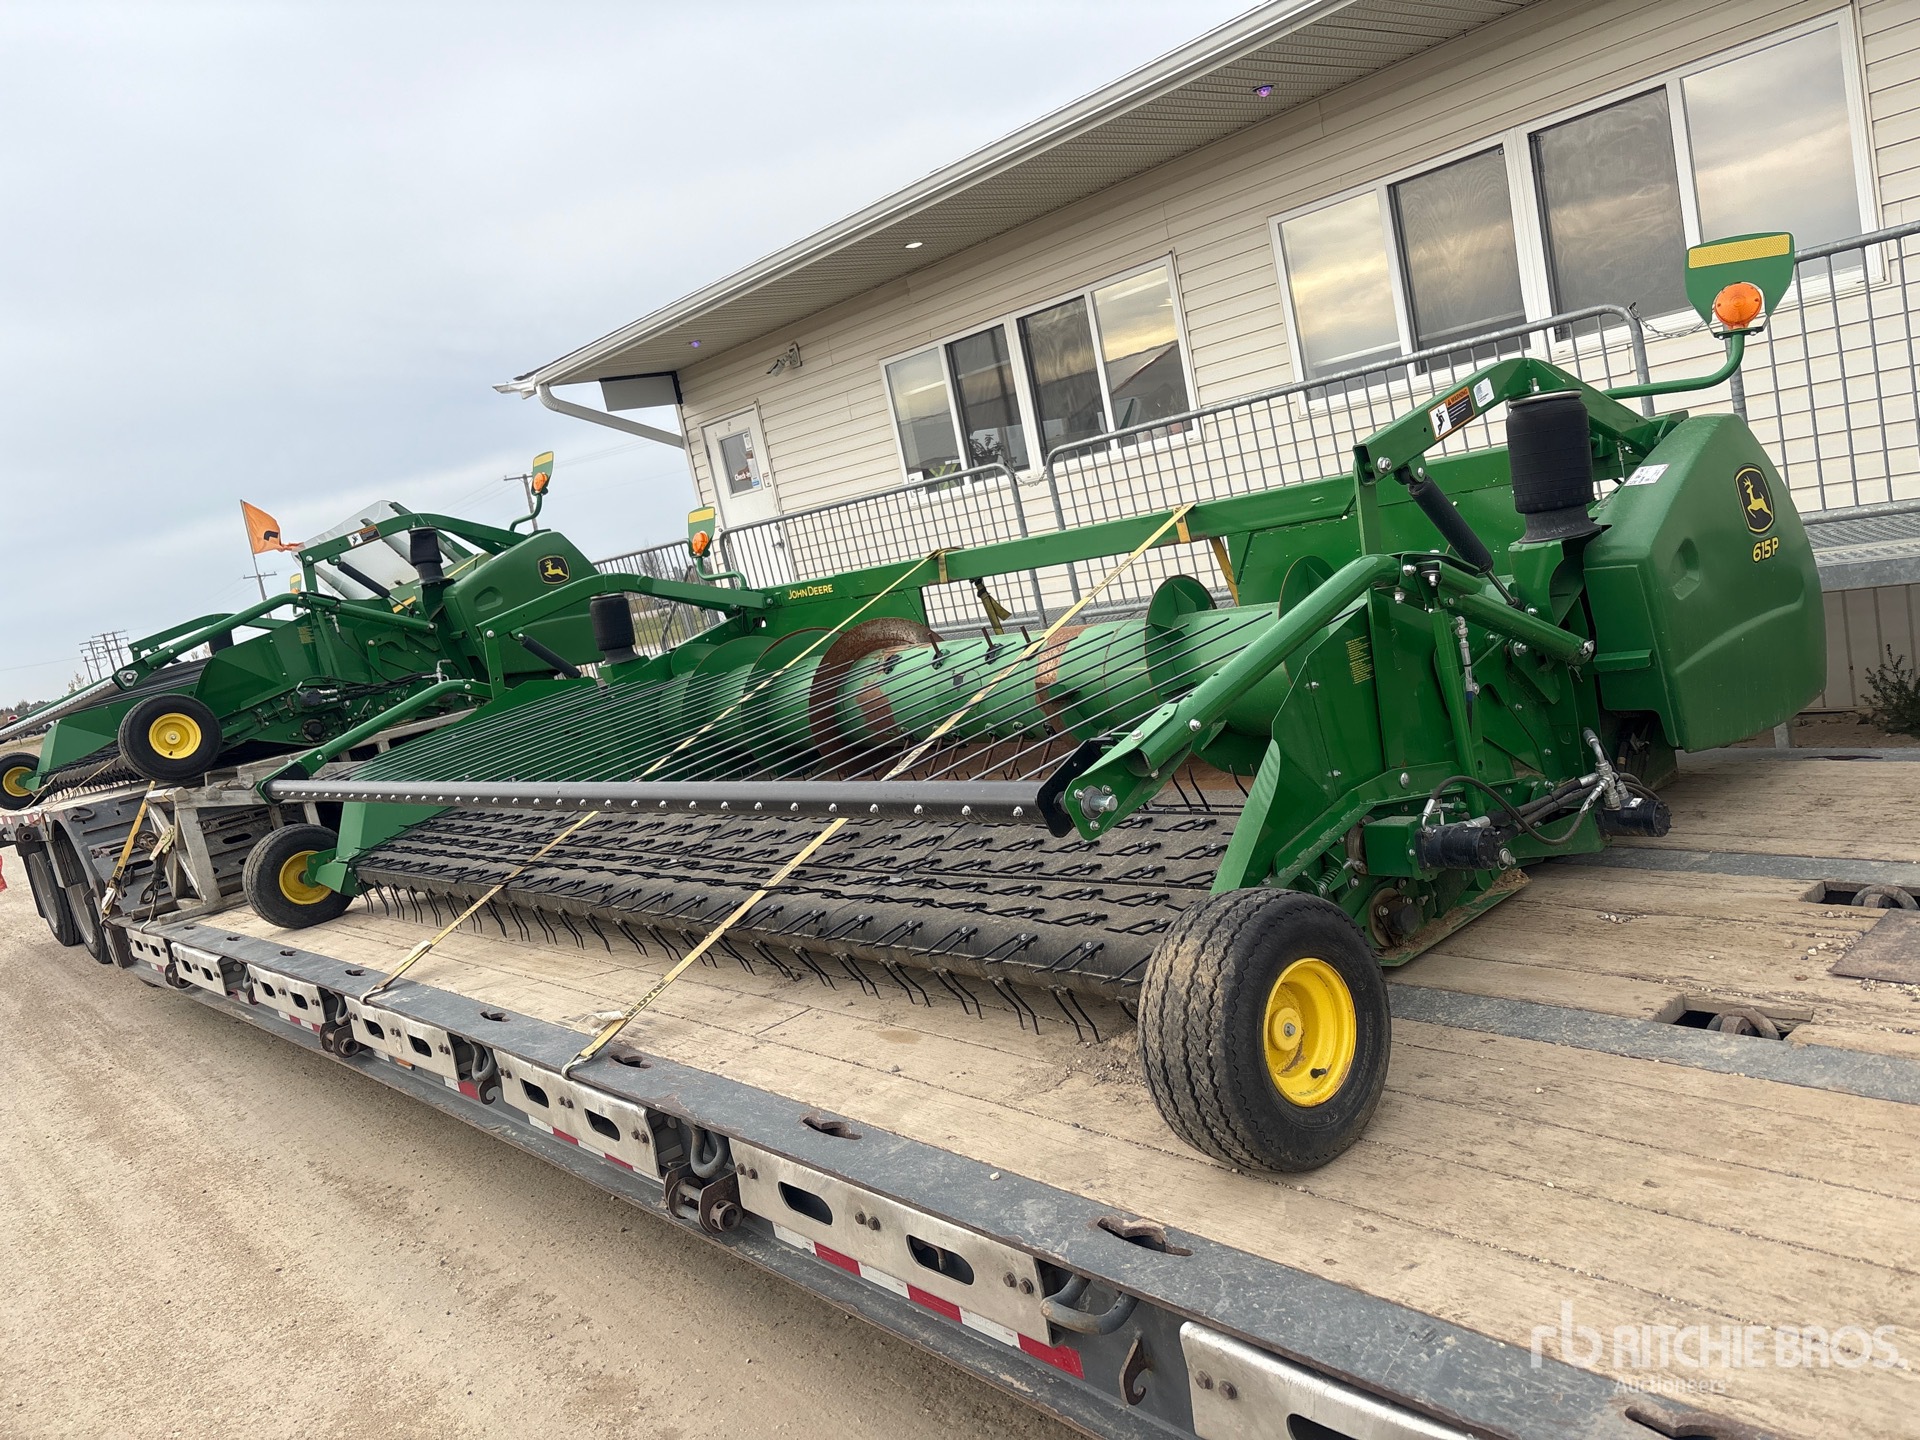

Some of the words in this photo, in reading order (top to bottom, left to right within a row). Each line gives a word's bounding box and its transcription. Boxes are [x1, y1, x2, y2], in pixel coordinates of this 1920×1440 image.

[1752, 536, 1779, 562] 615P
[788, 589, 807, 600] JOHN
[807, 584, 834, 597] DEERE
